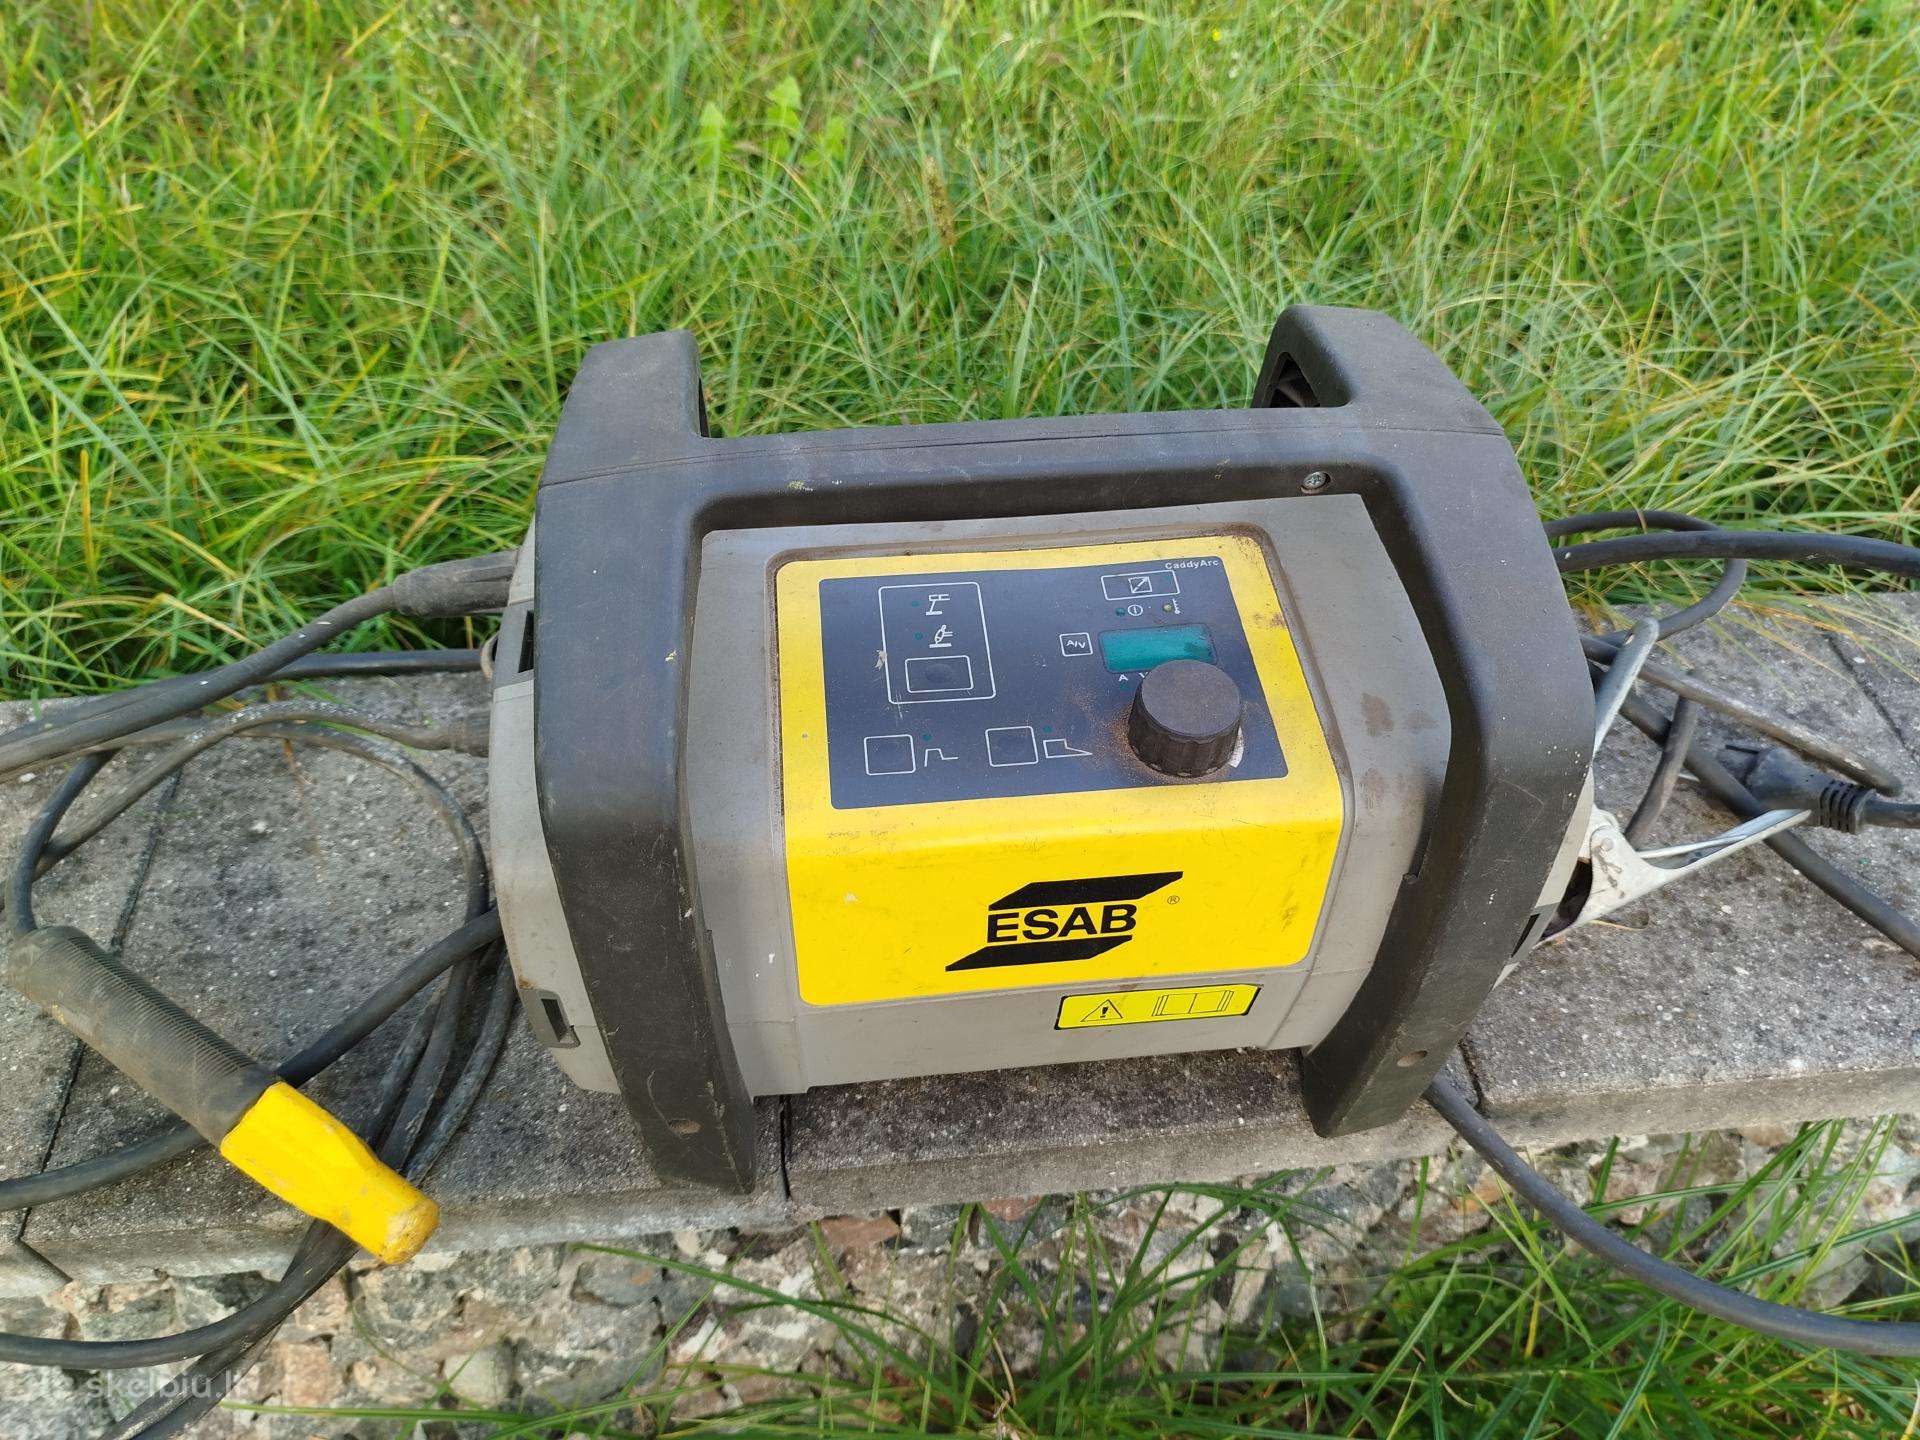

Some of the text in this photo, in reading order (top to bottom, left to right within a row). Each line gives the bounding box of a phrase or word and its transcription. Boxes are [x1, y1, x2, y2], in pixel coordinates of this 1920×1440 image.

[1165, 560, 1219, 569] CaddyArc
[1066, 639, 1086, 649] A/V
[1118, 674, 1129, 682] A
[987, 903, 1137, 943] ESAB
